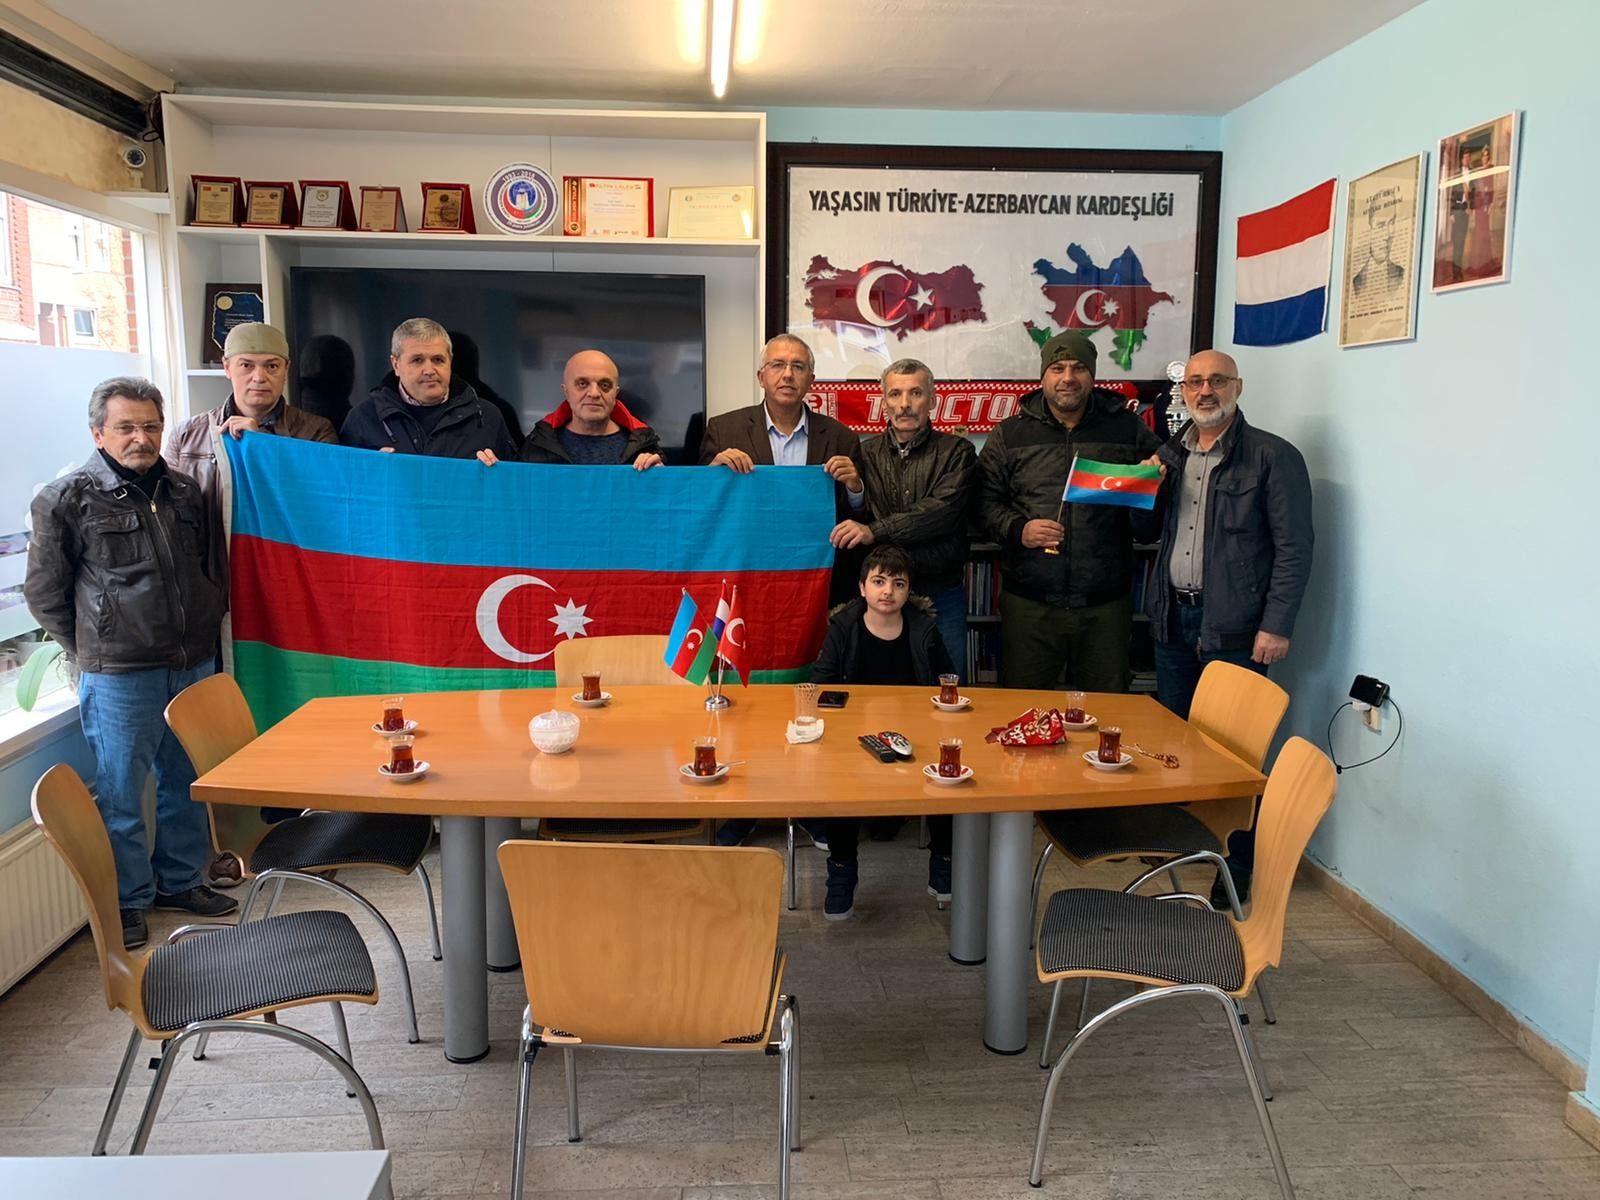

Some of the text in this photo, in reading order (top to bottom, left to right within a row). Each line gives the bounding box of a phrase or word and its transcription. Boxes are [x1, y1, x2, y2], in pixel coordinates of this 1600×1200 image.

[809, 188, 1174, 221] YAŞASIN TÜRKİYE-AZERBAYCAN KARDEŞLİĞİ
